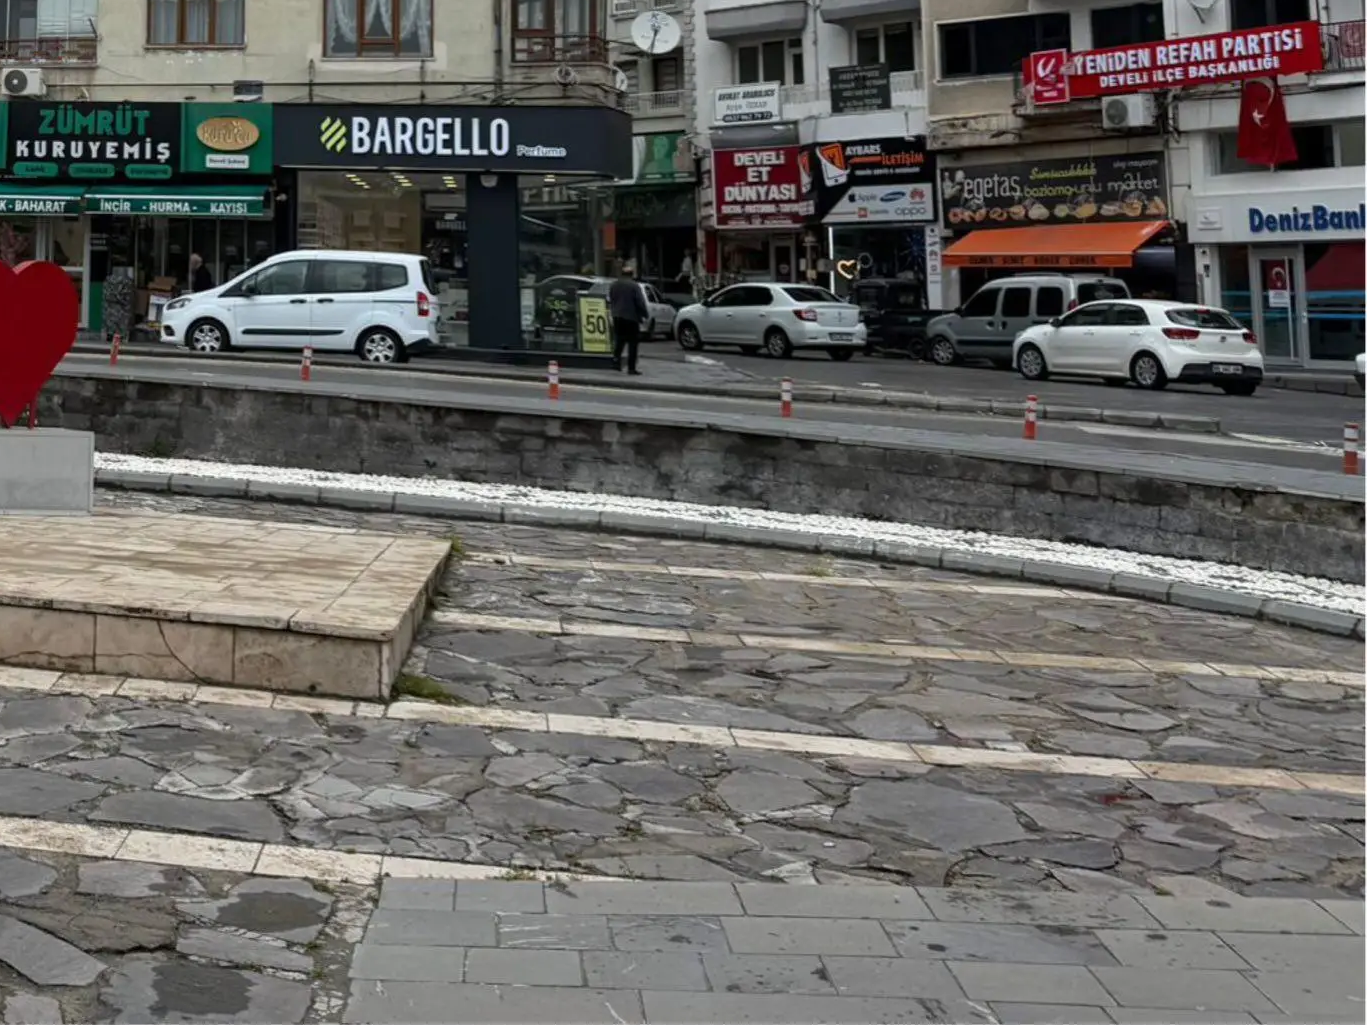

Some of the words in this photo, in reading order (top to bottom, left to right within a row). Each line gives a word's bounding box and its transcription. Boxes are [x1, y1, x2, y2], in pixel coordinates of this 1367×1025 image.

[1156, 40, 1217, 66] REFAH
[38, 105, 150, 136] ZÜMRÜT
[351, 116, 509, 157] BARGELLO
[16, 138, 171, 163] KURUYEMİŞ
[845, 144, 882, 156] AYBARS
[747, 167, 772, 182] ET
[724, 182, 797, 202] DÜNYASI
[15, 201, 66, 213] BAHARAT
[149, 202, 190, 212] HURMA
